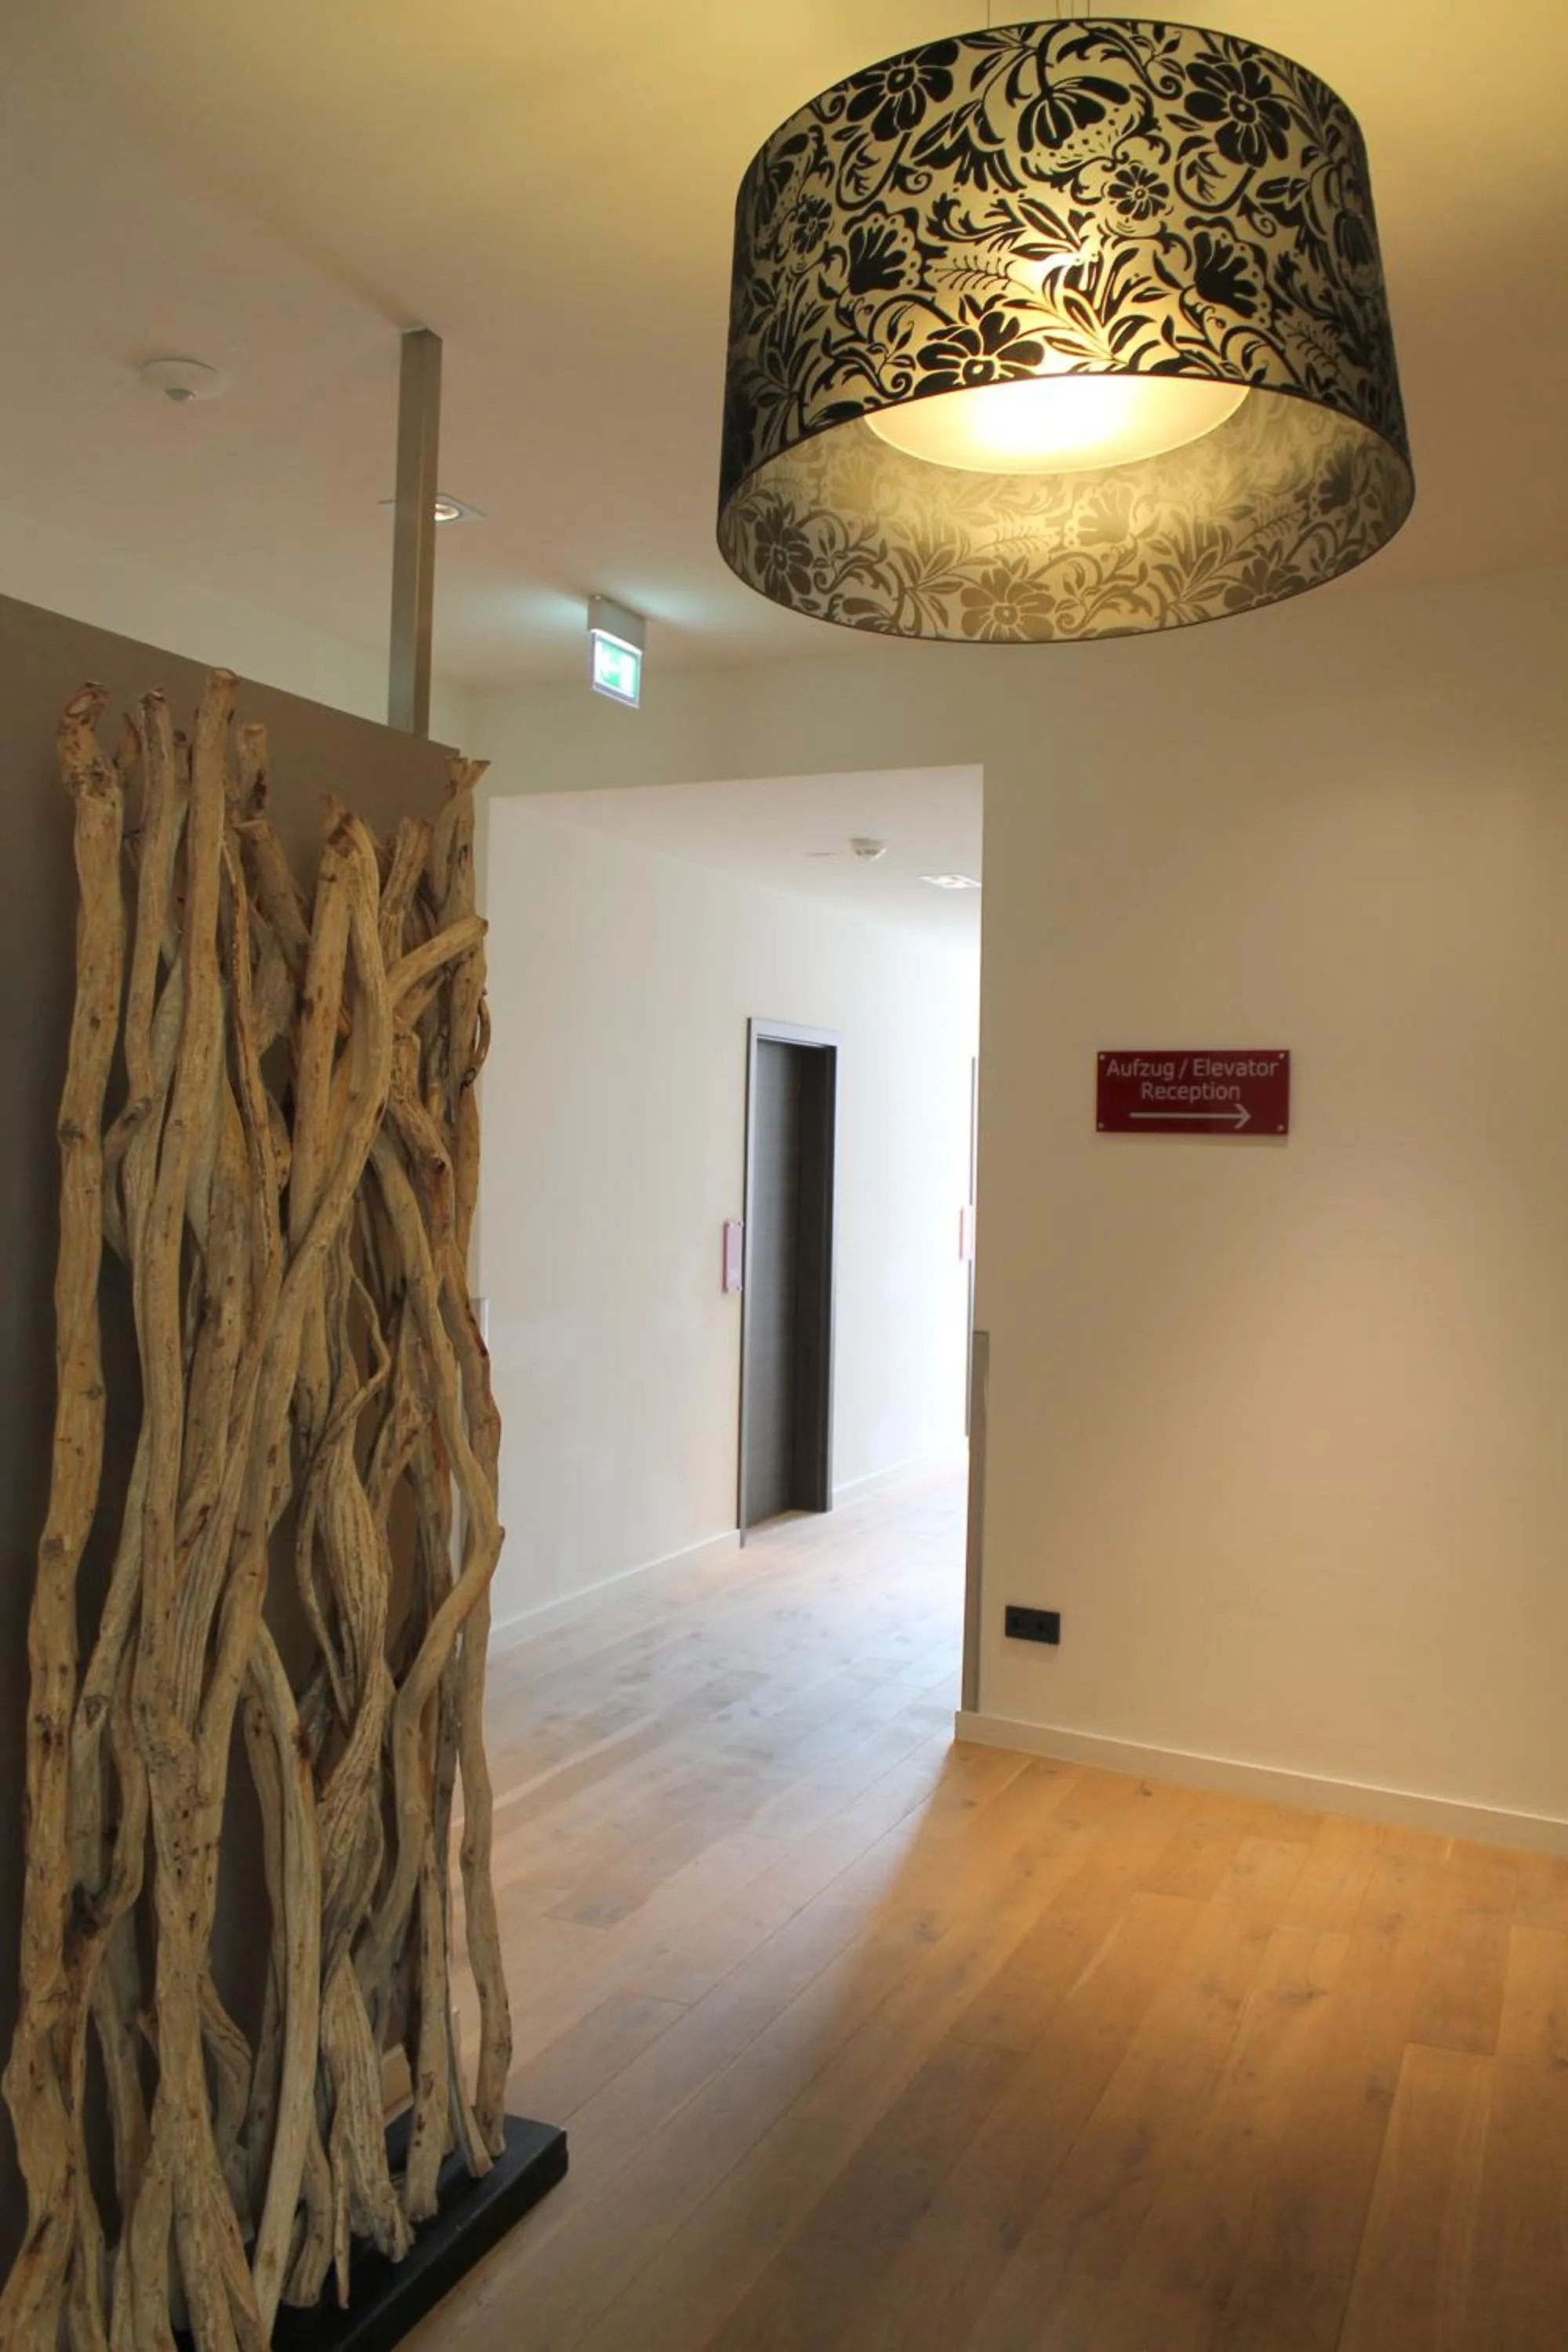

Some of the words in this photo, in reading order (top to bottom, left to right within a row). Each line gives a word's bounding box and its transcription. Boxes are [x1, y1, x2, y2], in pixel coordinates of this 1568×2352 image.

[1106, 1058, 1175, 1081] Aufzug
[1192, 1058, 1279, 1077] Elevator
[1142, 1081, 1241, 1104] Reception
